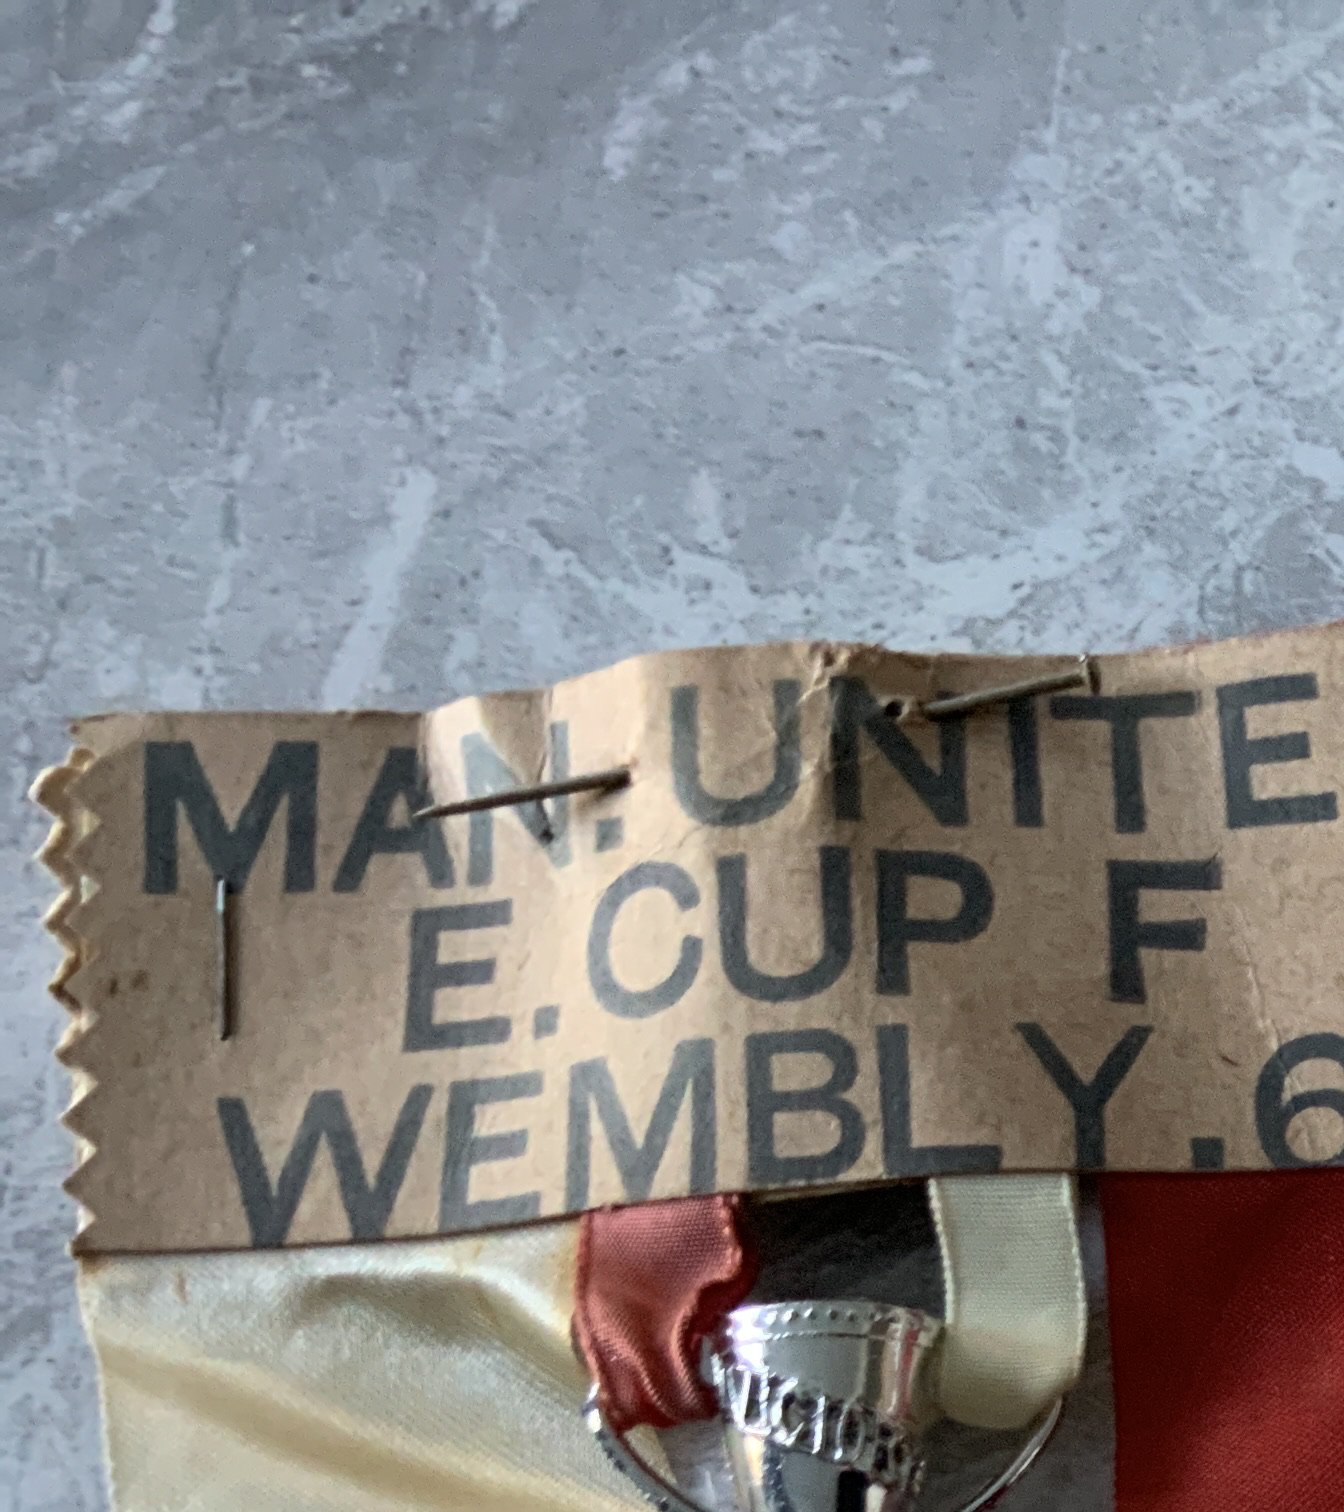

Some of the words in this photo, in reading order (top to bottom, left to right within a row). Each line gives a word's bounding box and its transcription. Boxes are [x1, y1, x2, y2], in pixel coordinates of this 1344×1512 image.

[141, 720, 624, 894] MAN.
[1106, 856, 1224, 1004] F
[216, 1021, 1154, 1247] WEMBLY
